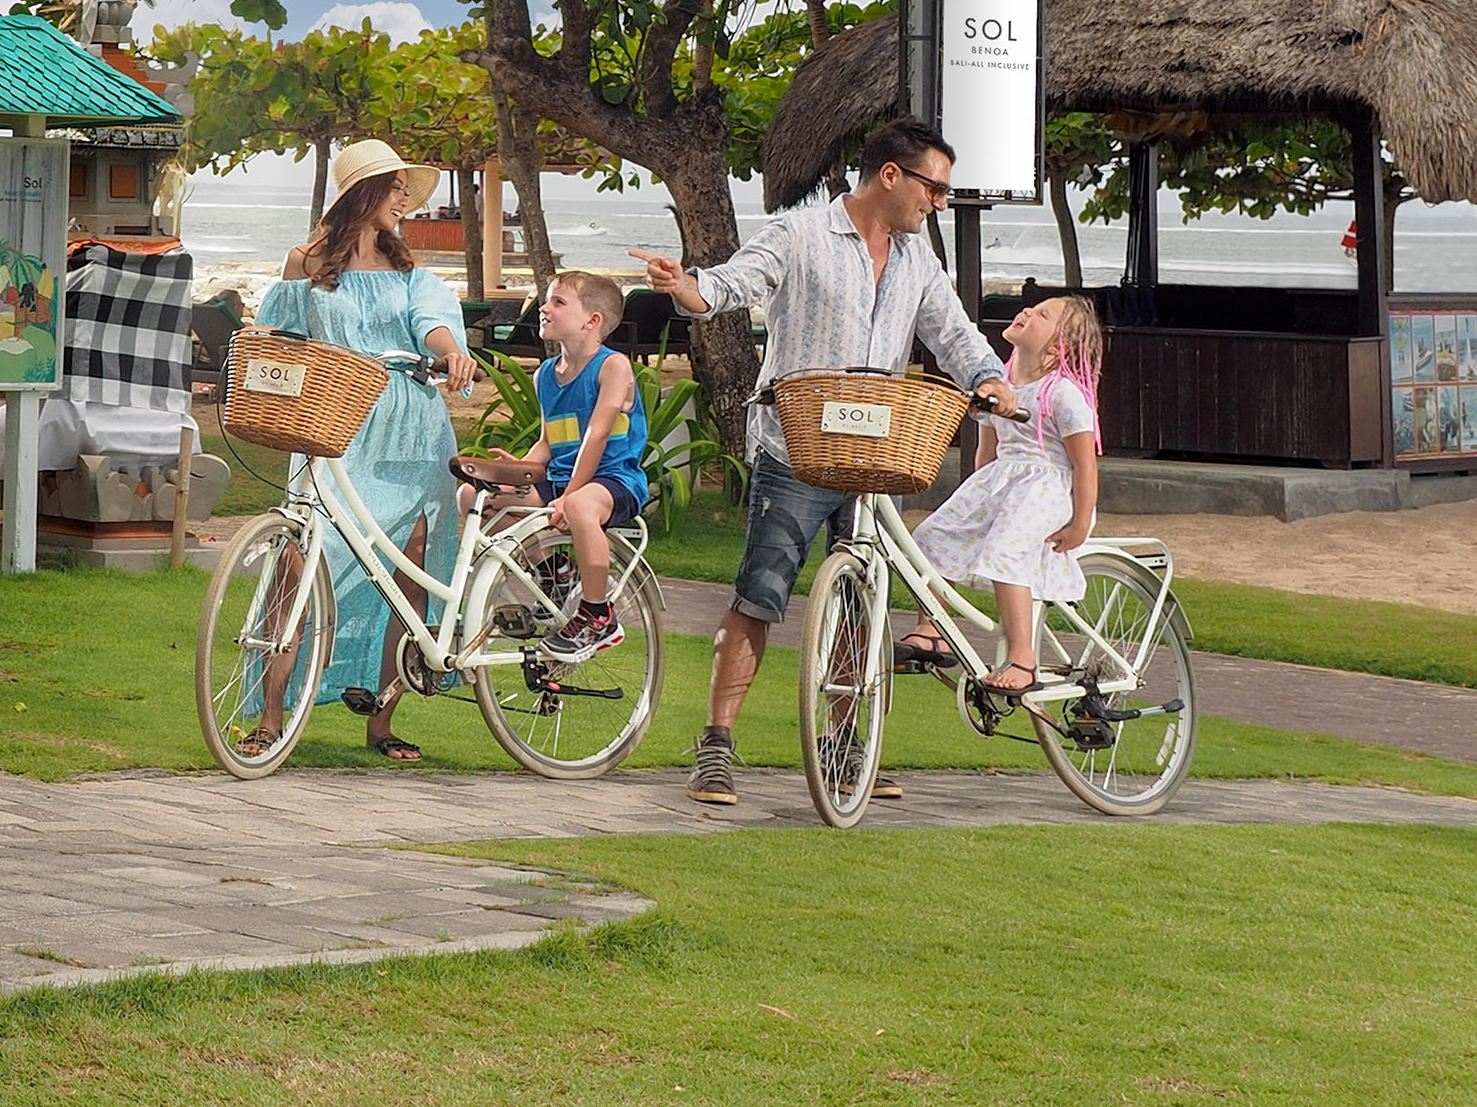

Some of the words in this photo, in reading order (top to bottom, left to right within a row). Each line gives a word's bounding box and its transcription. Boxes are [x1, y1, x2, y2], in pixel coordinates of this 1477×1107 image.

[964, 18, 1017, 41] SOL
[971, 46, 1009, 56] BENOA
[987, 62, 1029, 71] INCLUSIVE
[24, 177, 42, 189] Sol
[259, 366, 289, 382] SOL
[838, 408, 874, 423] SOL
